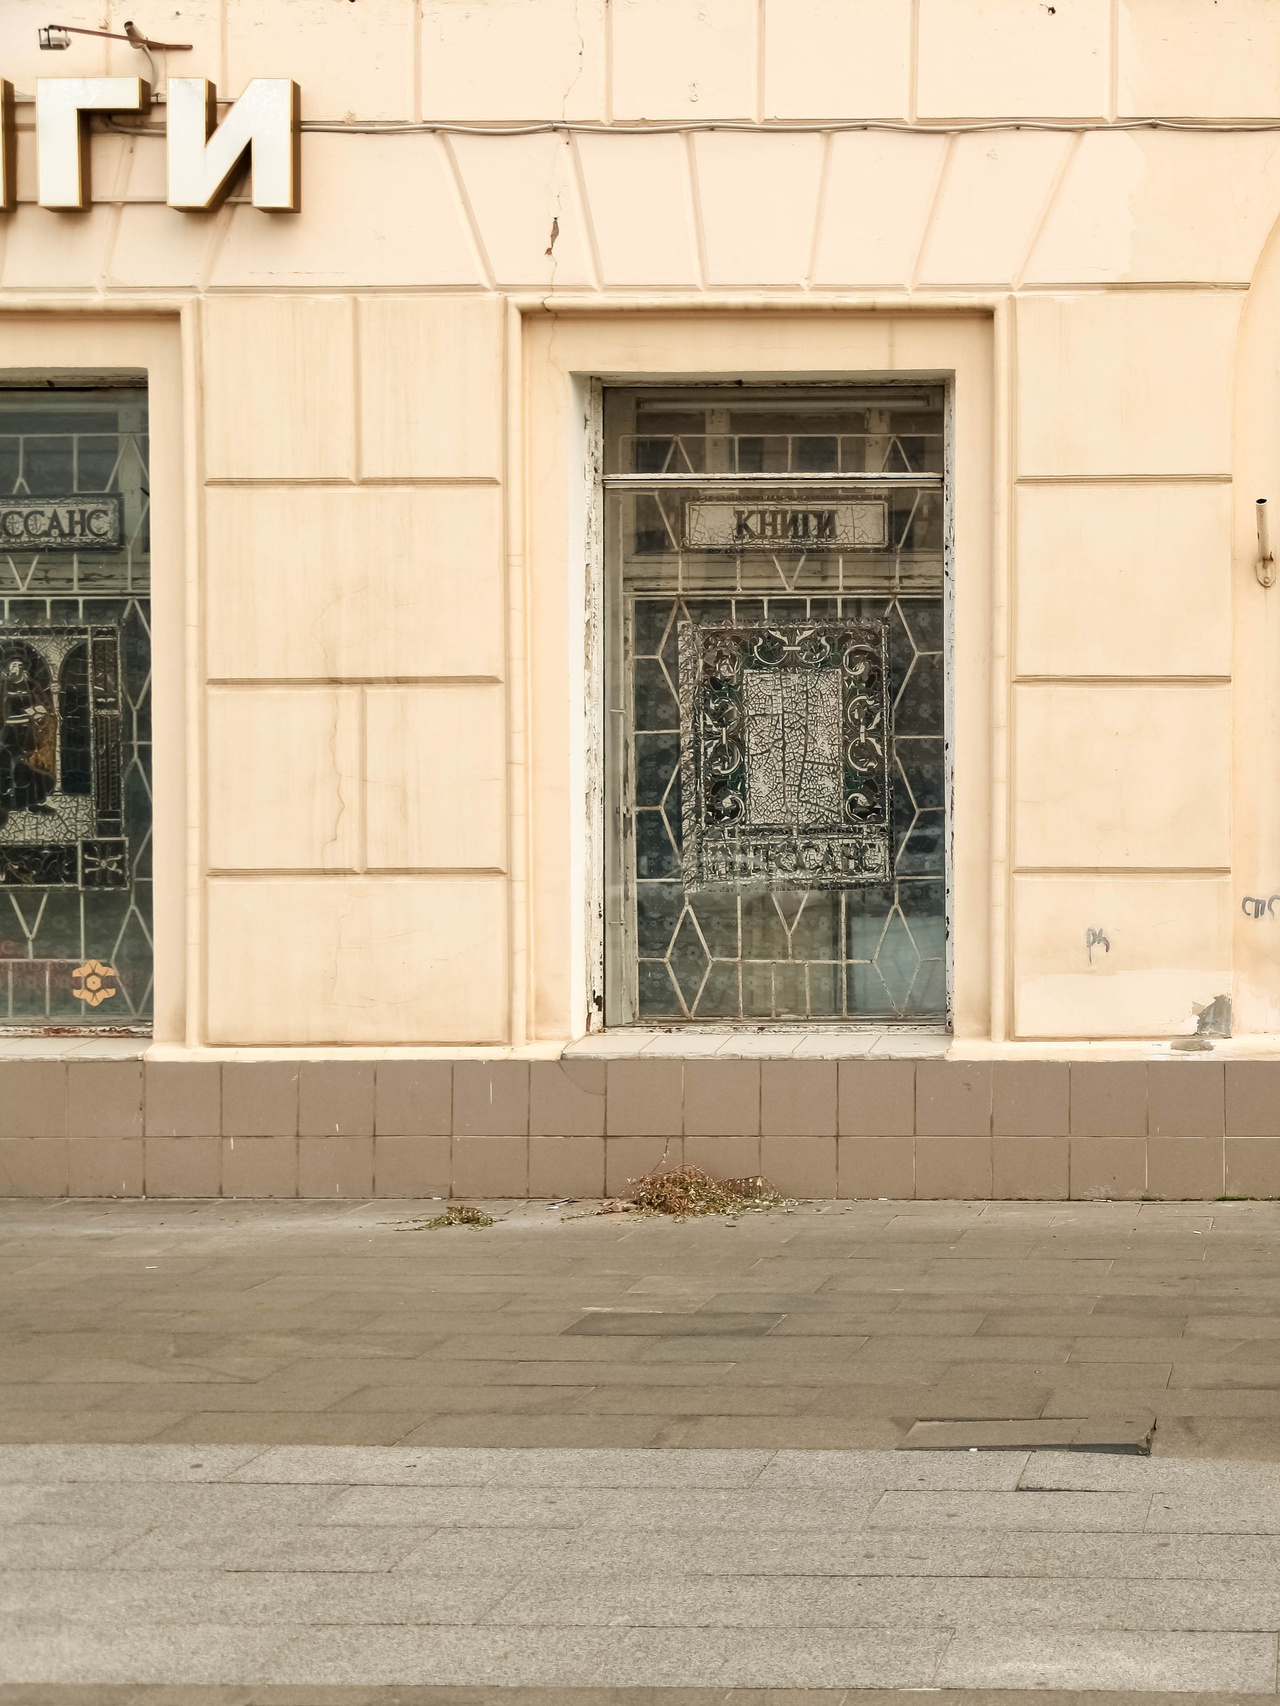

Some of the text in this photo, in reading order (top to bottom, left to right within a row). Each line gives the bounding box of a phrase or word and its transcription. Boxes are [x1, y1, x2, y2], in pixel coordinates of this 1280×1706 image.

[0, 77, 301, 213] ГИ
[0, 509, 108, 538] ССАНС
[733, 509, 838, 539] КНИГИ
